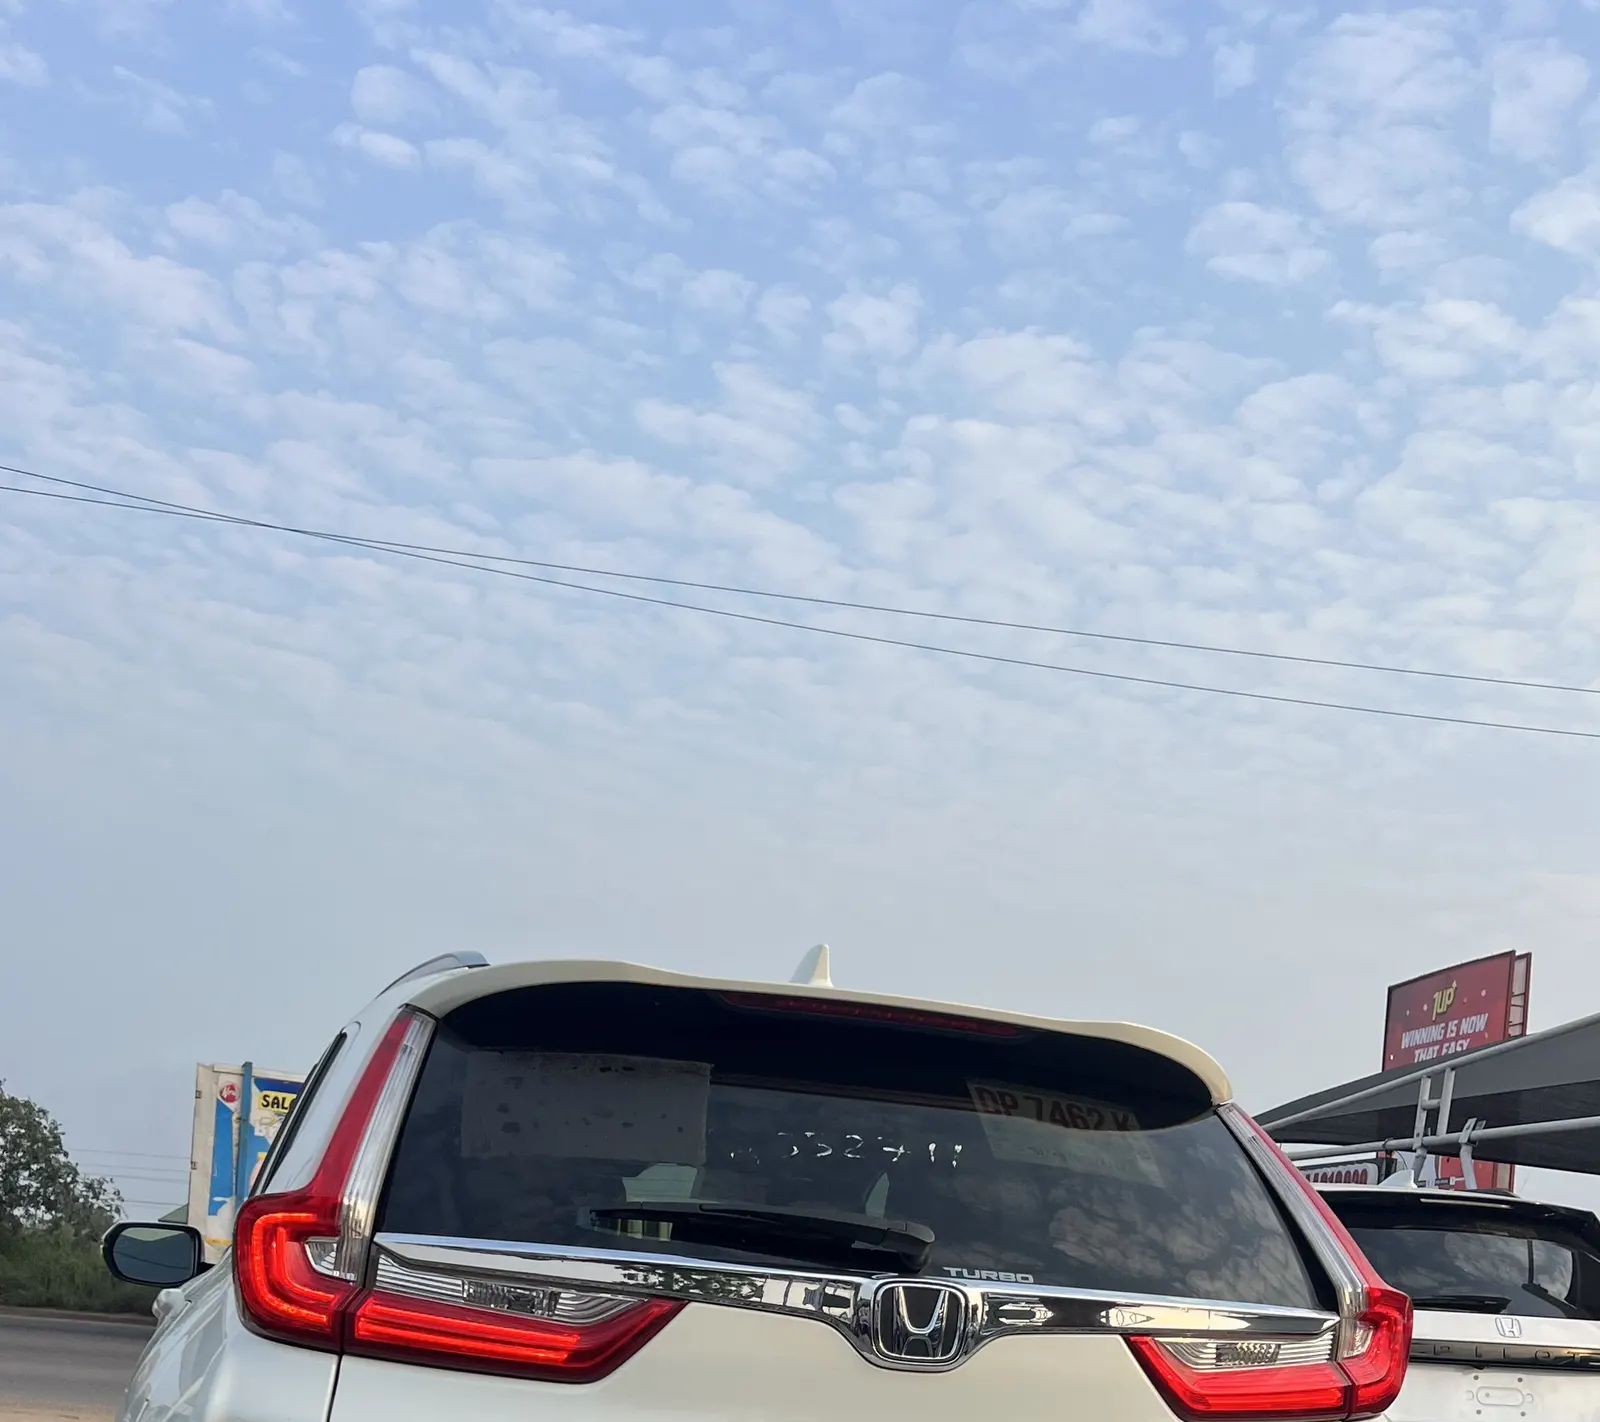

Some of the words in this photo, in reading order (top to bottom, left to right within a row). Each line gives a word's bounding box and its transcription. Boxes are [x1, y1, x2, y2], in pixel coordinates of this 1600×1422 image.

[1401, 1022, 1446, 1049] WINNING
[1446, 1019, 1459, 1038] IS
[1460, 1012, 1489, 1036] NOW
[1414, 1045, 1440, 1063] THAT
[942, 1266, 1034, 1283] TURBO
